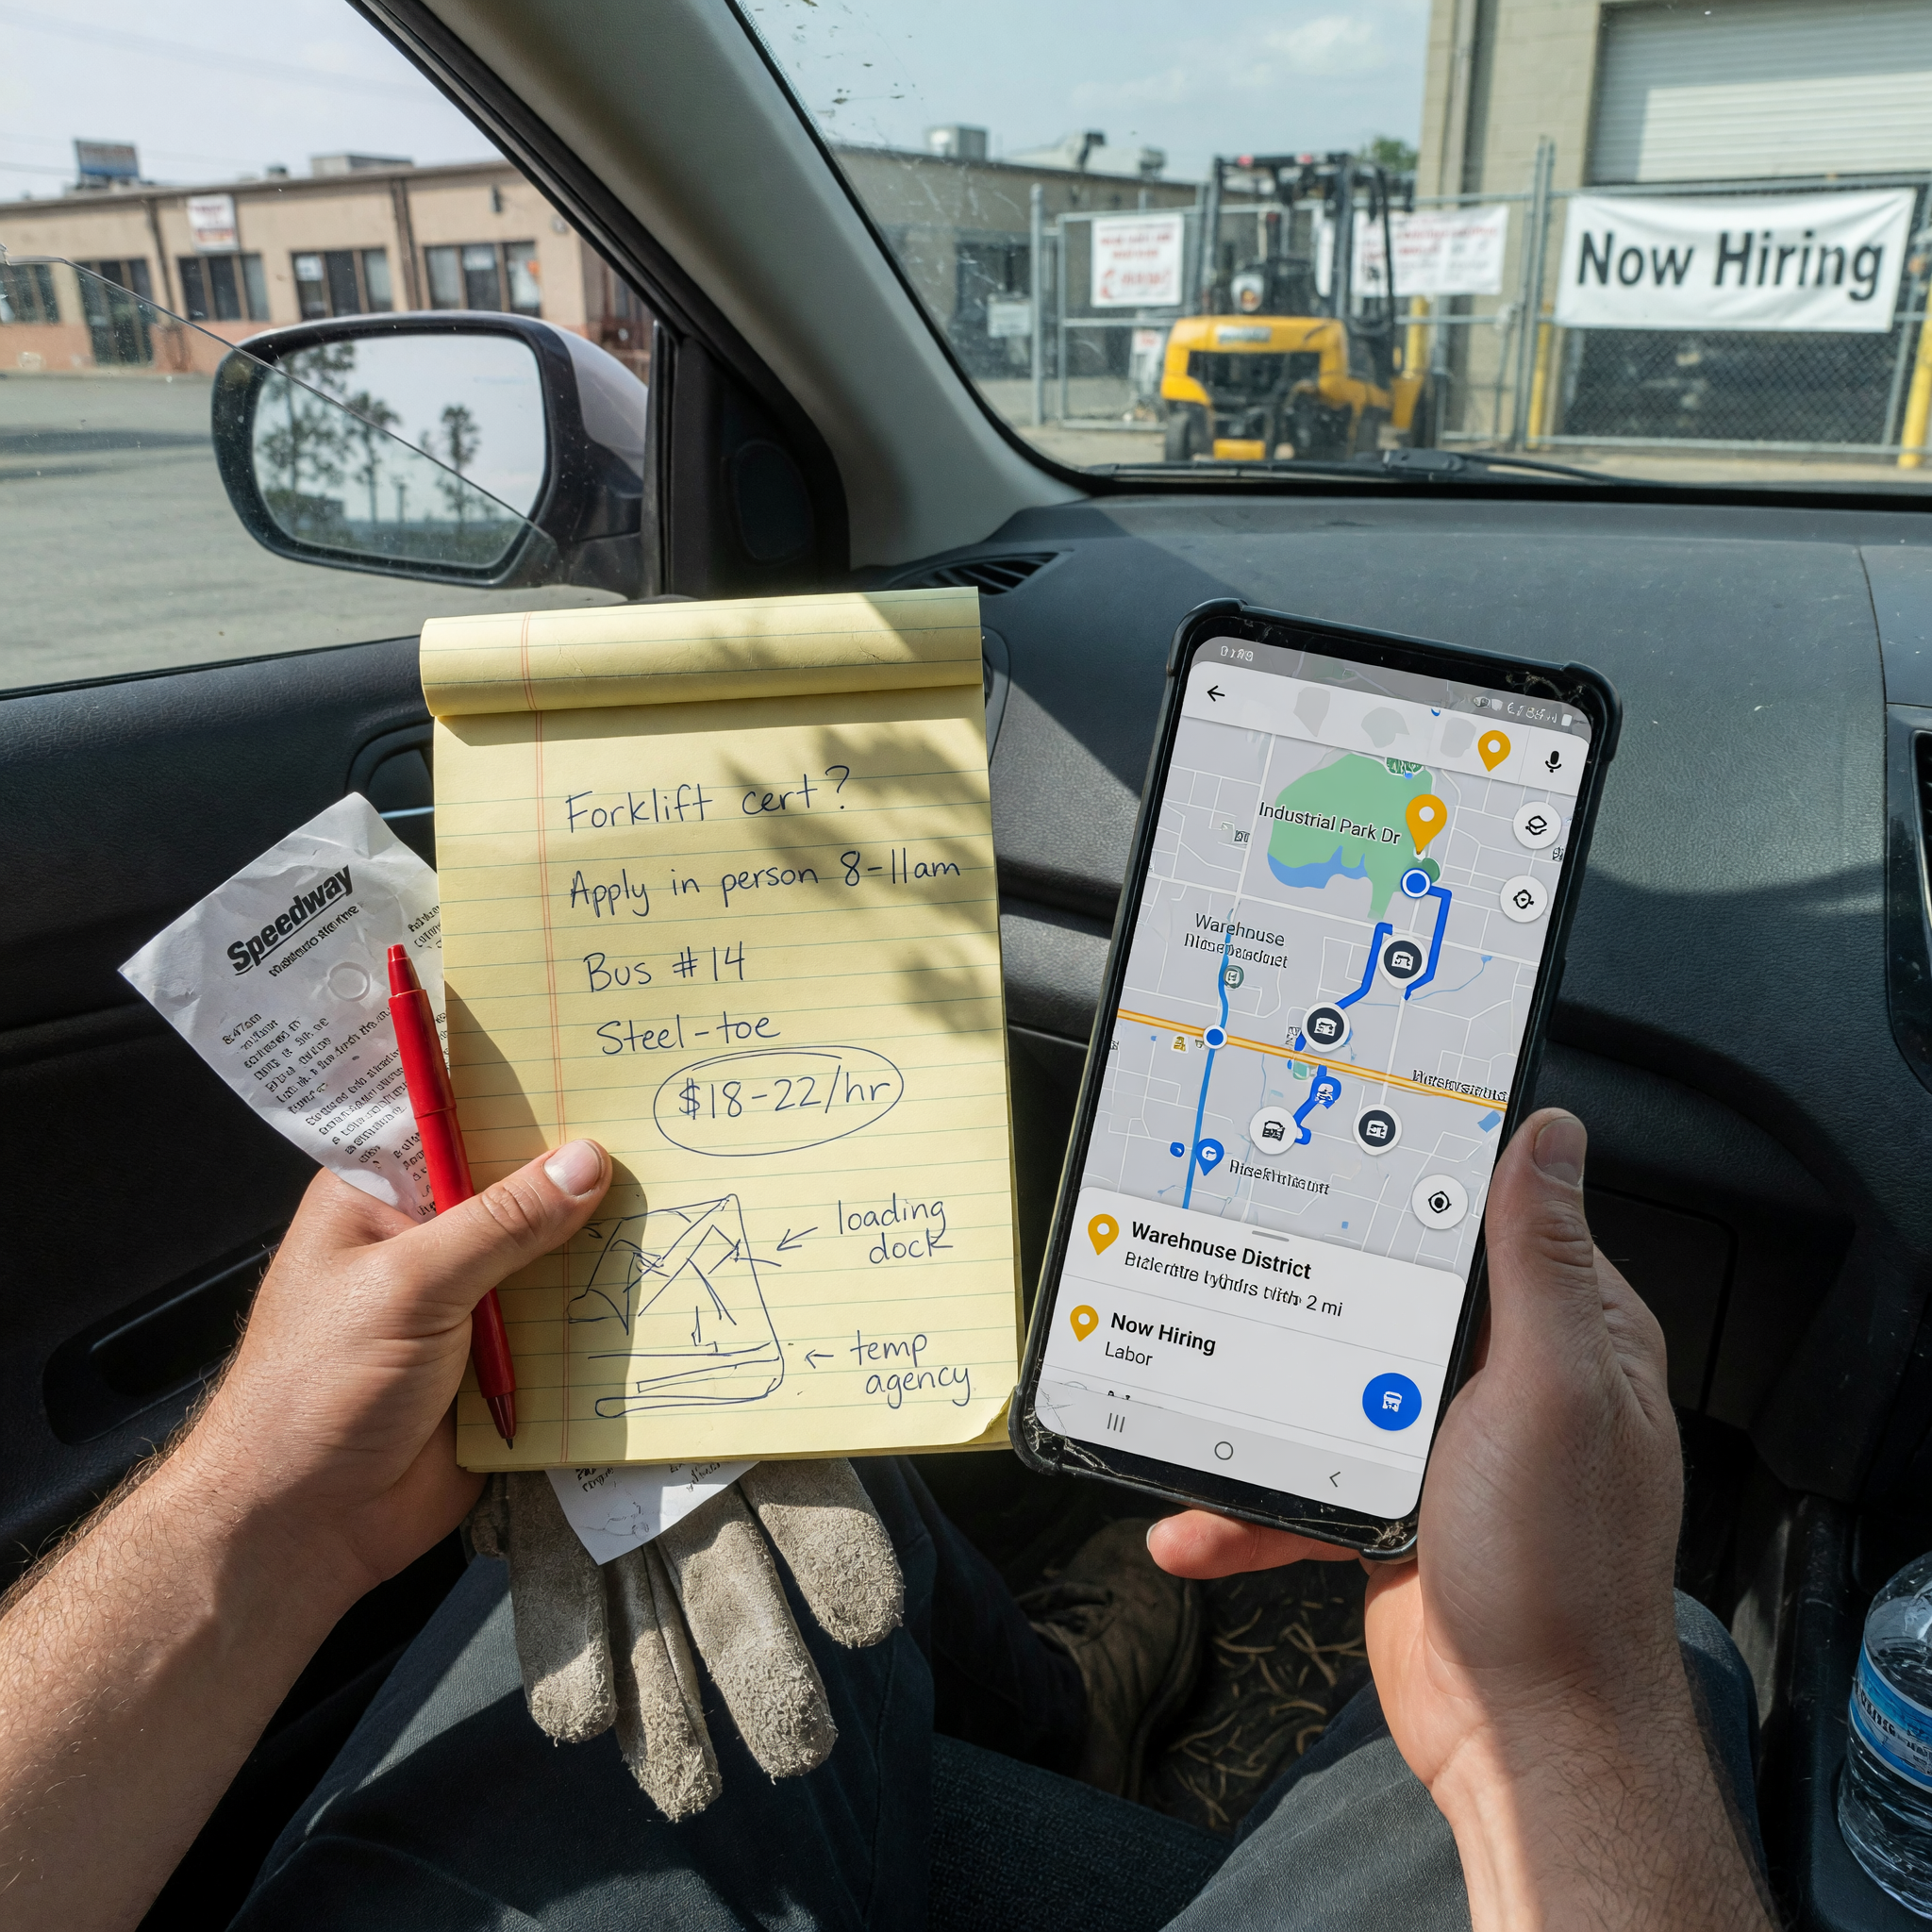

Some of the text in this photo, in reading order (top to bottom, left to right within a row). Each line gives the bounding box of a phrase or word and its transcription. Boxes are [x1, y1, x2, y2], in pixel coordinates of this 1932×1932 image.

[1578, 230, 1883, 301] Now Hiring
[566, 765, 850, 833] Forklift cert?
[1258, 802, 1401, 844] Industrial Park Dr
[570, 869, 650, 918] Apply
[671, 869, 700, 896] in
[721, 866, 819, 908] person
[226, 864, 353, 972] Speedway
[583, 941, 744, 992] Bus #14
[678, 1065, 891, 1120] $18-22/hr
[838, 1192, 946, 1247] loading
[869, 1228, 954, 1264] dock
[1241, 1247, 1311, 1280] District
[1306, 1294, 1343, 1317] 2 mi
[850, 1330, 928, 1368] temp
[1105, 1341, 1154, 1366] Labor
[1110, 1312, 1217, 1357] Now Hiring
[865, 1366, 972, 1410] agency
